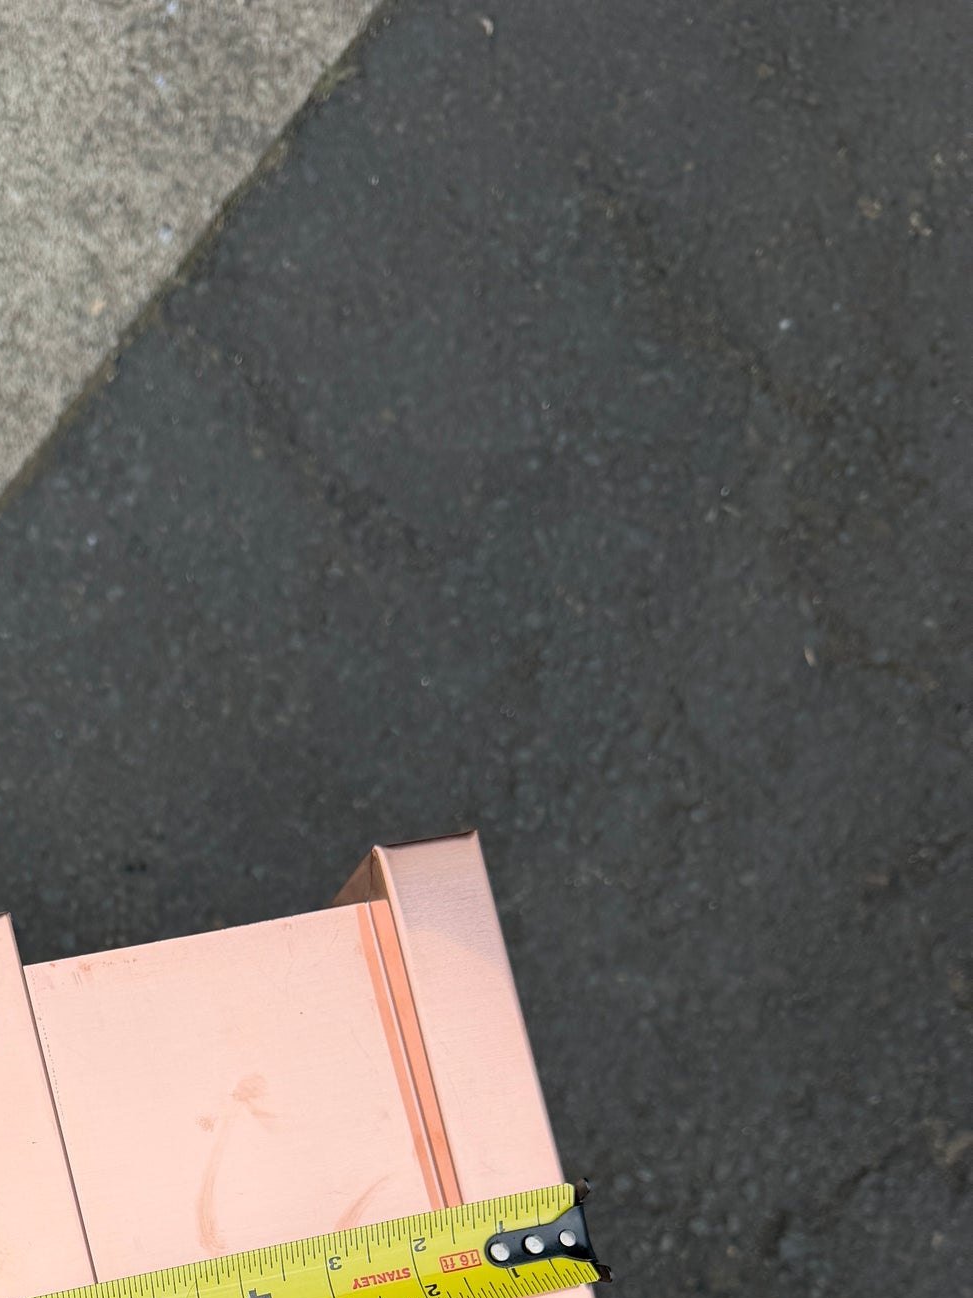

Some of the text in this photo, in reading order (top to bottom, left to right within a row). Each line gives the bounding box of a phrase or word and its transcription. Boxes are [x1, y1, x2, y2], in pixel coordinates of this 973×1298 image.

[413, 1237, 427, 1253] 2
[328, 1256, 343, 1271] 3
[443, 1253, 478, 1270] 16 ft
[352, 1267, 412, 1290] STANLEY
[510, 1267, 521, 1279] 1
[424, 1284, 441, 1297] 2
